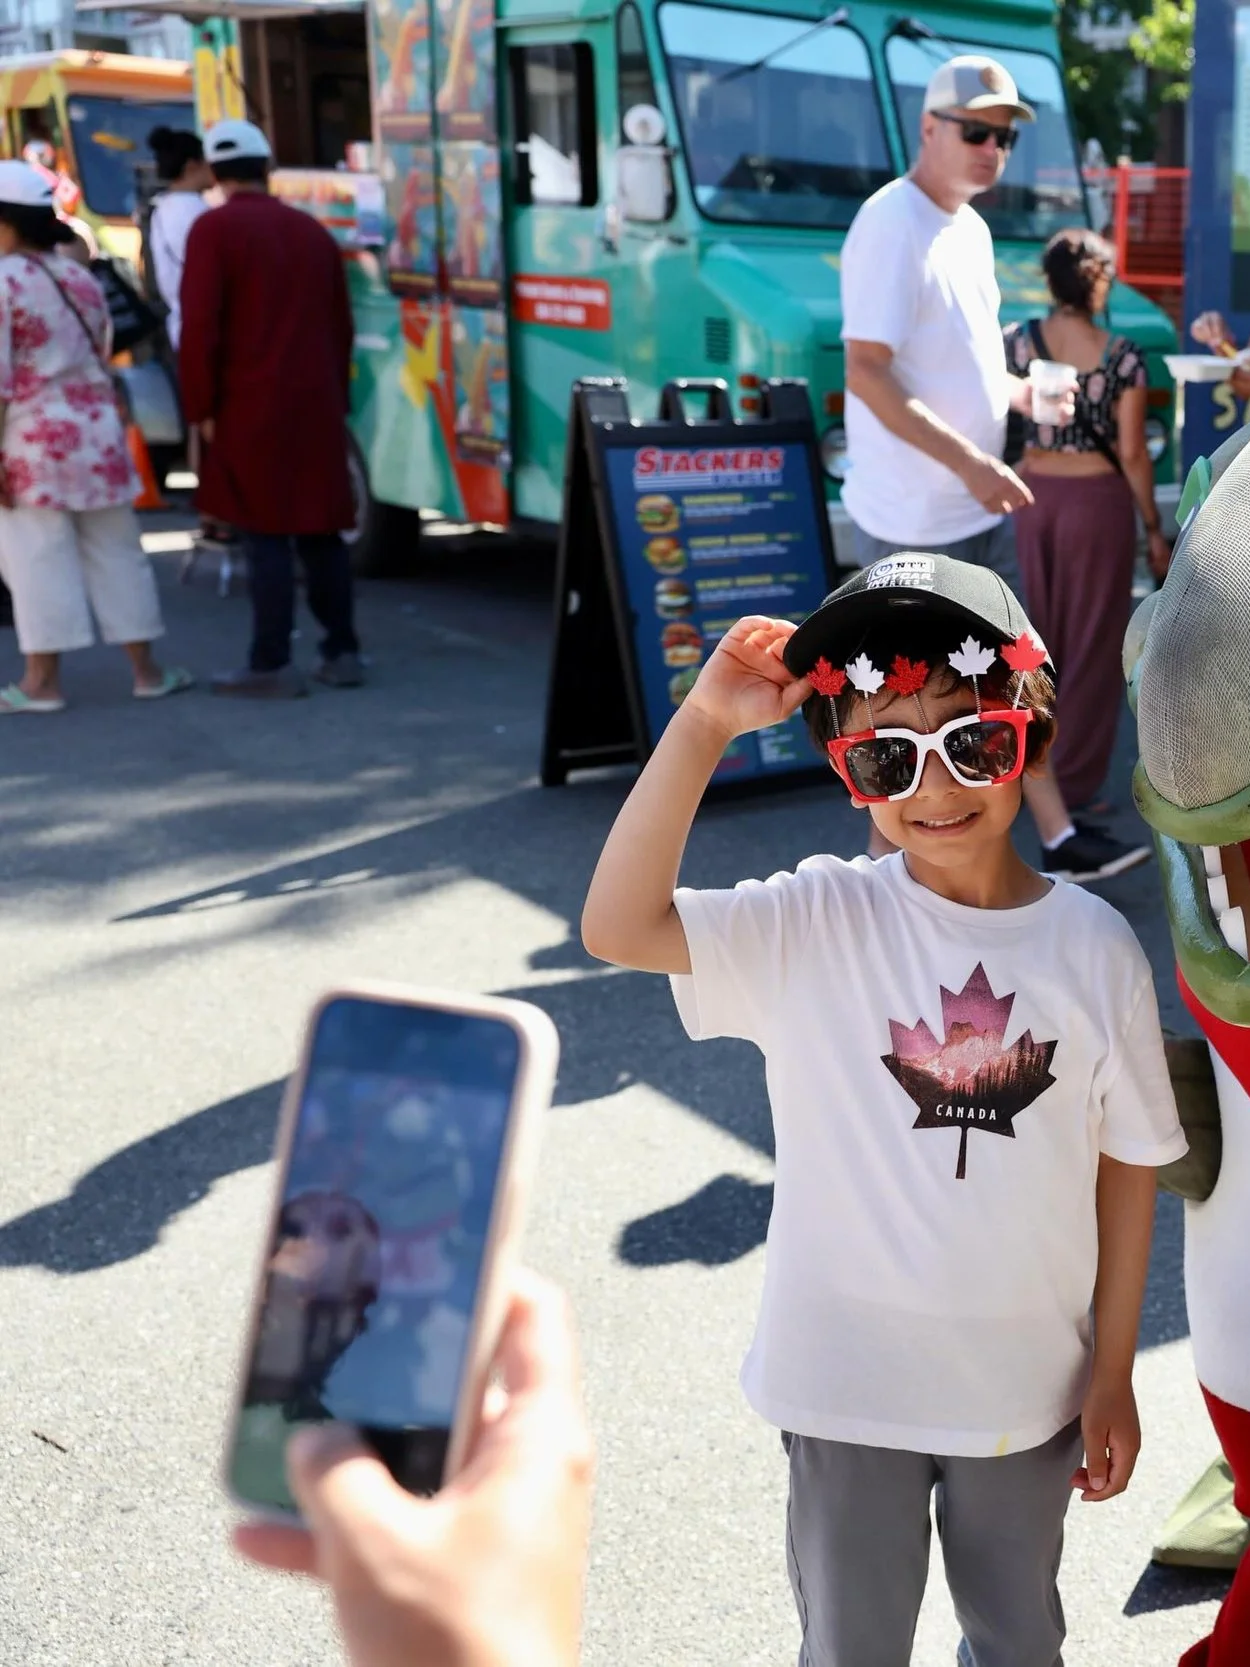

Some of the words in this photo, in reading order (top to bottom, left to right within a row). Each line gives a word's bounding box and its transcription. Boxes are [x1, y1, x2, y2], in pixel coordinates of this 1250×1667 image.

[638, 449, 782, 474] STACKERS
[895, 561, 927, 569] NTT
[936, 1103, 997, 1121] CANADA
